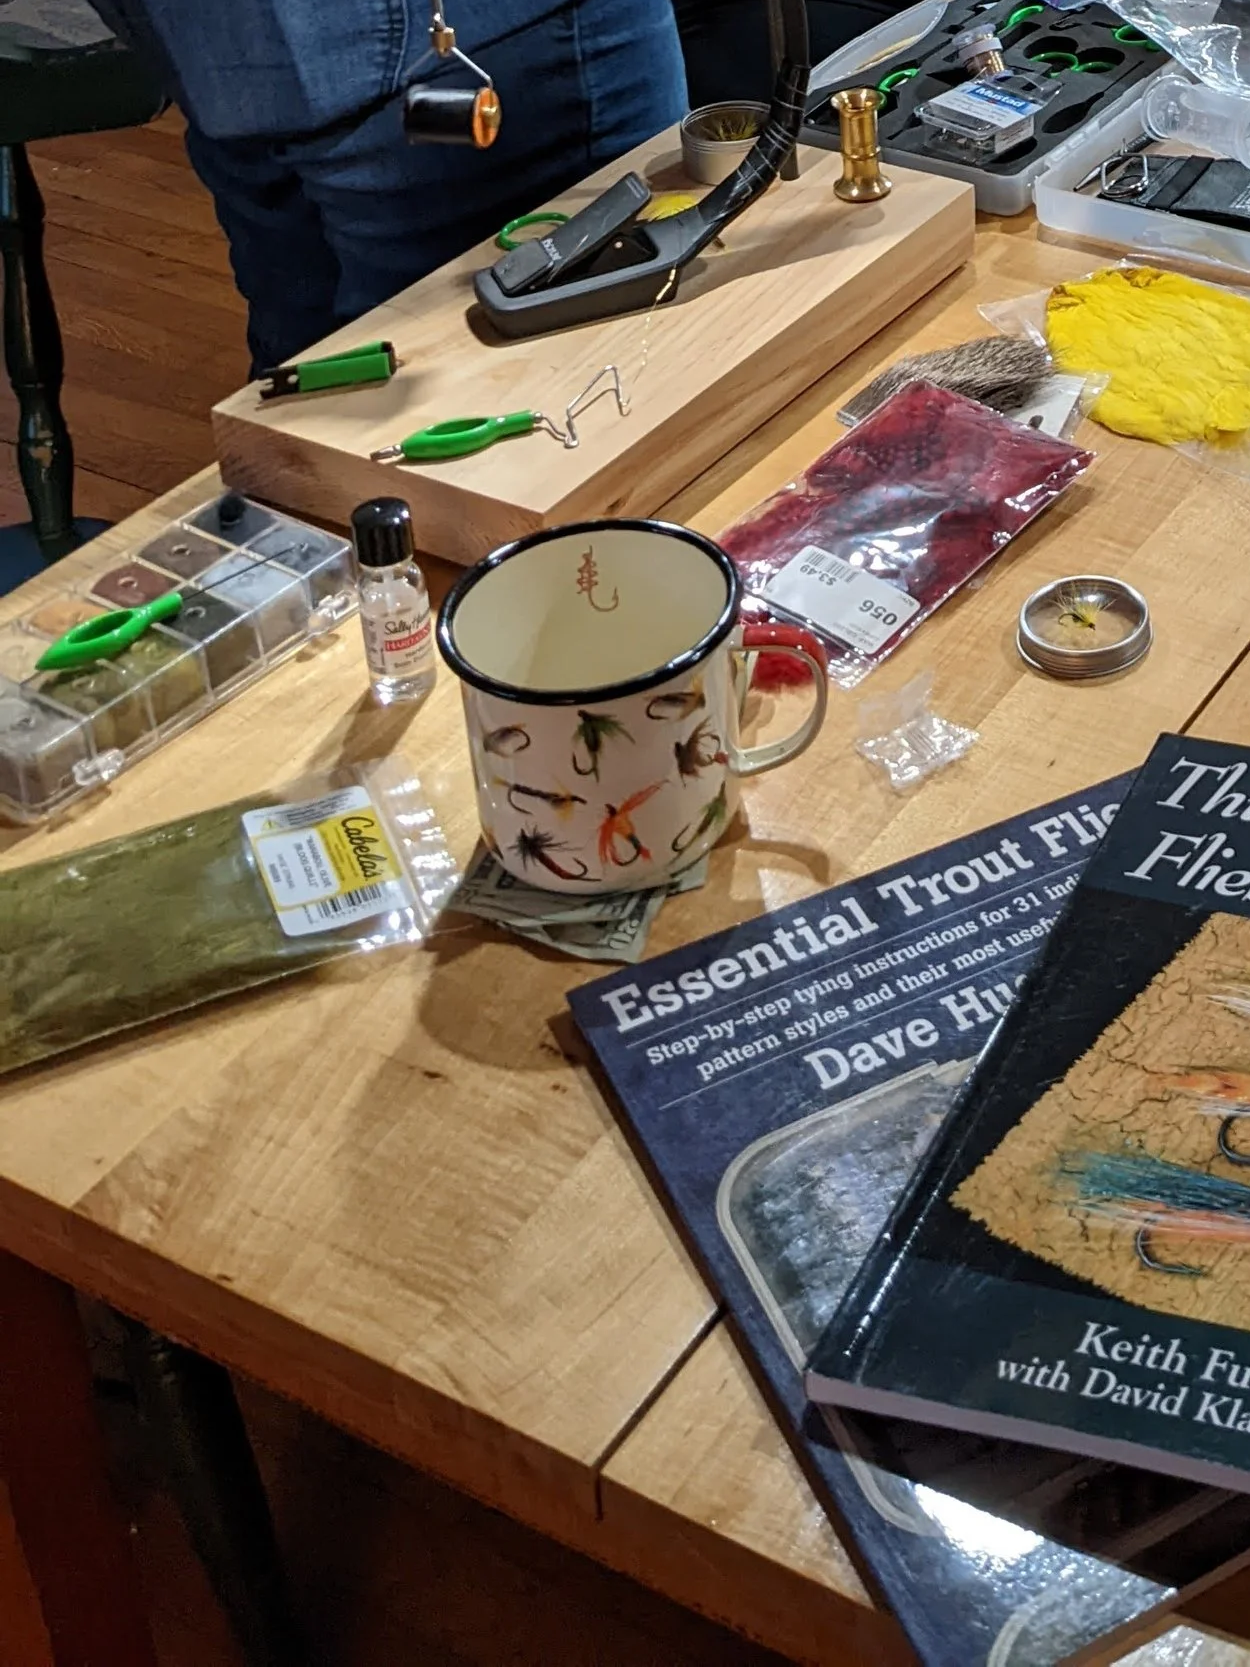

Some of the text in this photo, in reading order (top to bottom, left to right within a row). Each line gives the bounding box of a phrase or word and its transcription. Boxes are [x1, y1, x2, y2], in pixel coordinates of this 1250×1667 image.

[975, 87, 1026, 108] Mustad
[799, 564, 838, 586] $3.49
[858, 599, 898, 626] 056
[601, 896, 880, 1034] Essential
[877, 840, 1034, 917] Trout
[1030, 802, 1122, 859] Flie
[646, 893, 1042, 1067] Step-by-step tying instructions for 31
[696, 1032, 781, 1081] pattern
[784, 1004, 851, 1042] styles
[852, 985, 895, 1013] and
[896, 962, 950, 994] their
[951, 943, 1004, 971] most
[804, 1016, 941, 1091] Dave
[1075, 1320, 1187, 1376] Keith
[997, 1356, 1072, 1394] with
[1079, 1366, 1190, 1418] David
